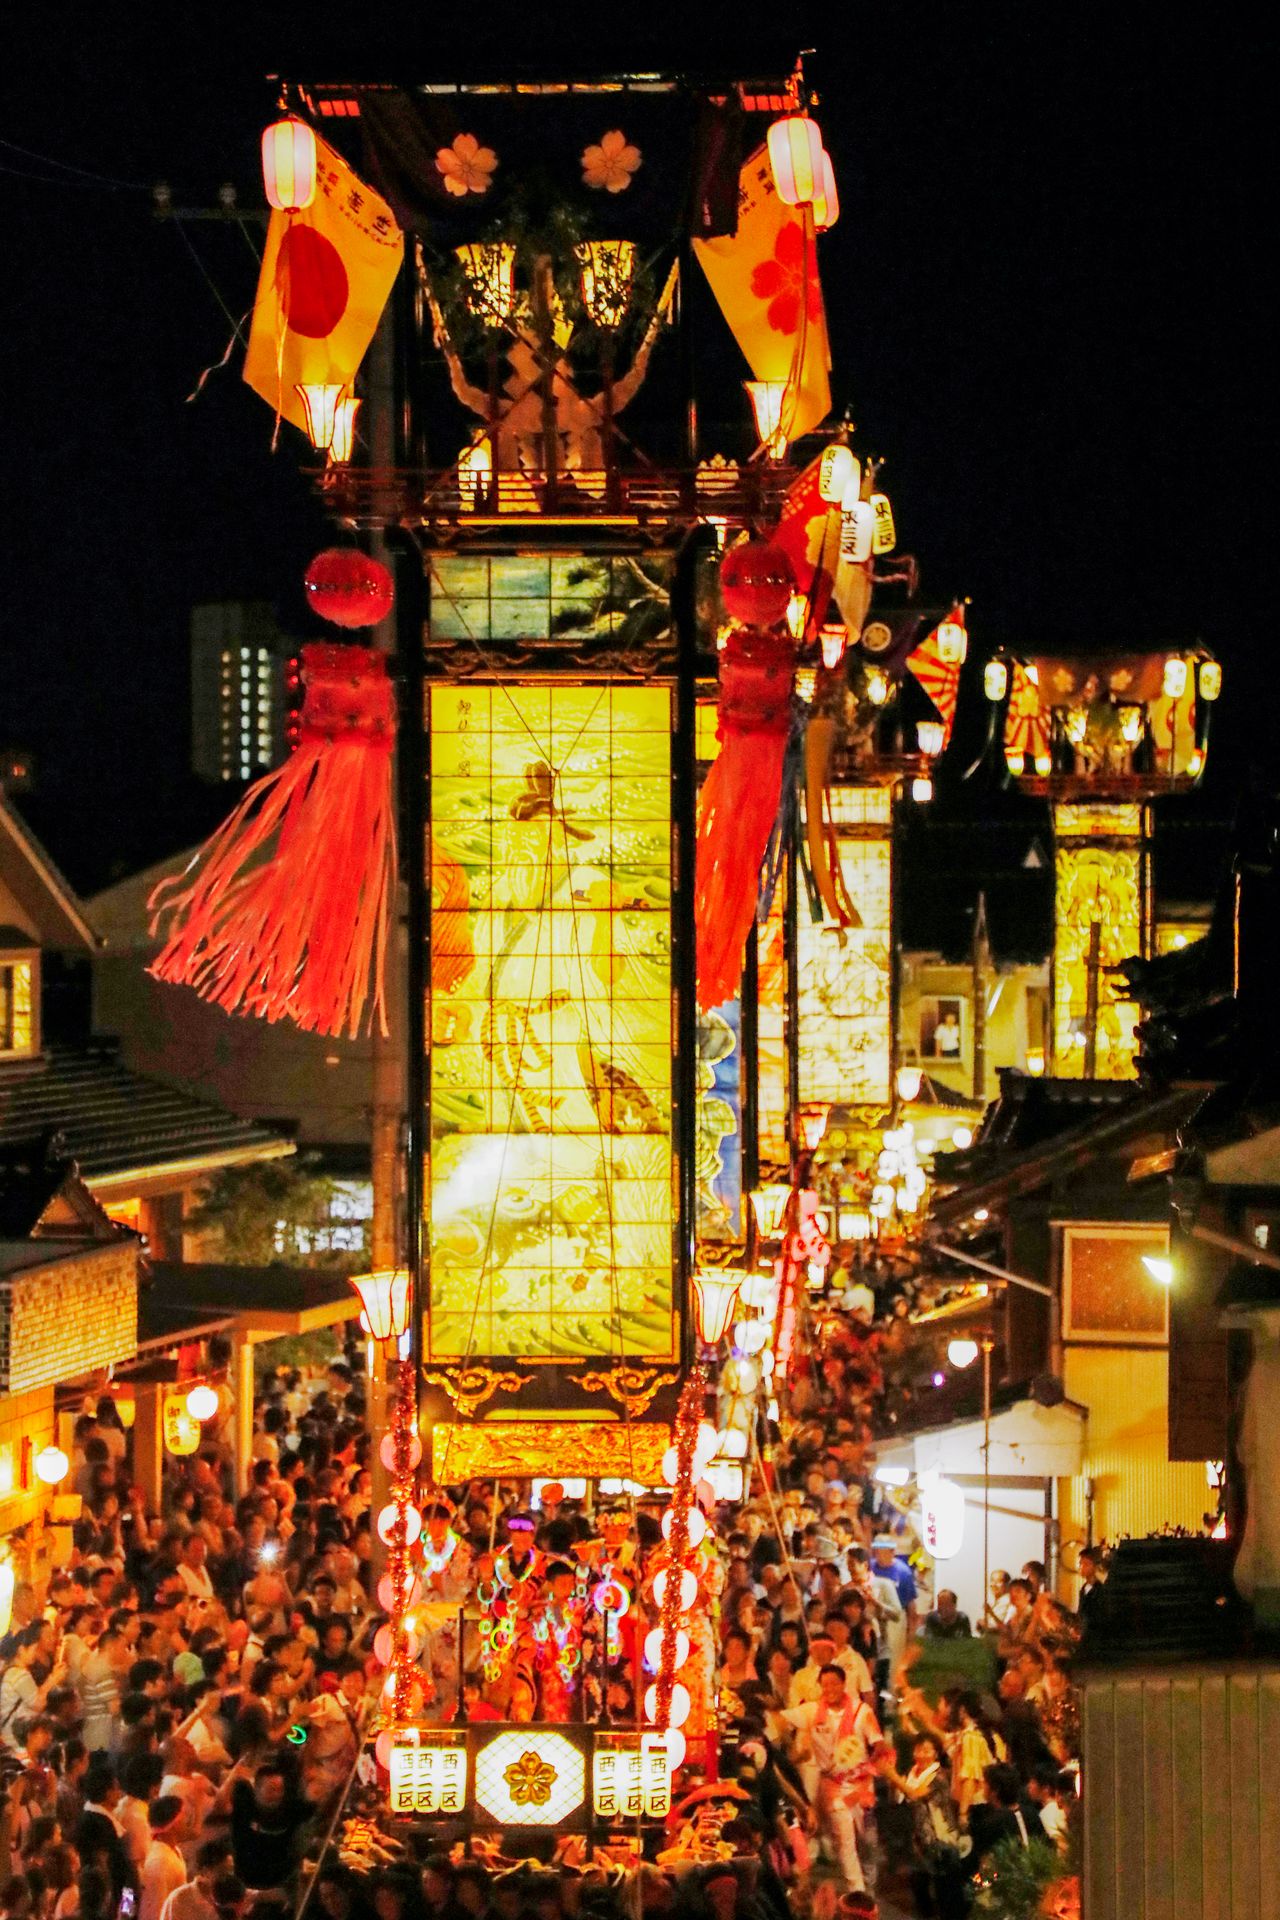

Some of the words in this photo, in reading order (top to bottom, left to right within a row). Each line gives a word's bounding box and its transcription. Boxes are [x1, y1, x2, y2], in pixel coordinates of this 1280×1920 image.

[398, 1753, 414, 1807] 西二区
[417, 1753, 433, 1807] 西二区
[441, 1753, 458, 1807] 西二区
[599, 1756, 616, 1811] 西二区
[627, 1756, 643, 1811] 西二区
[650, 1757, 667, 1812] 西二区
